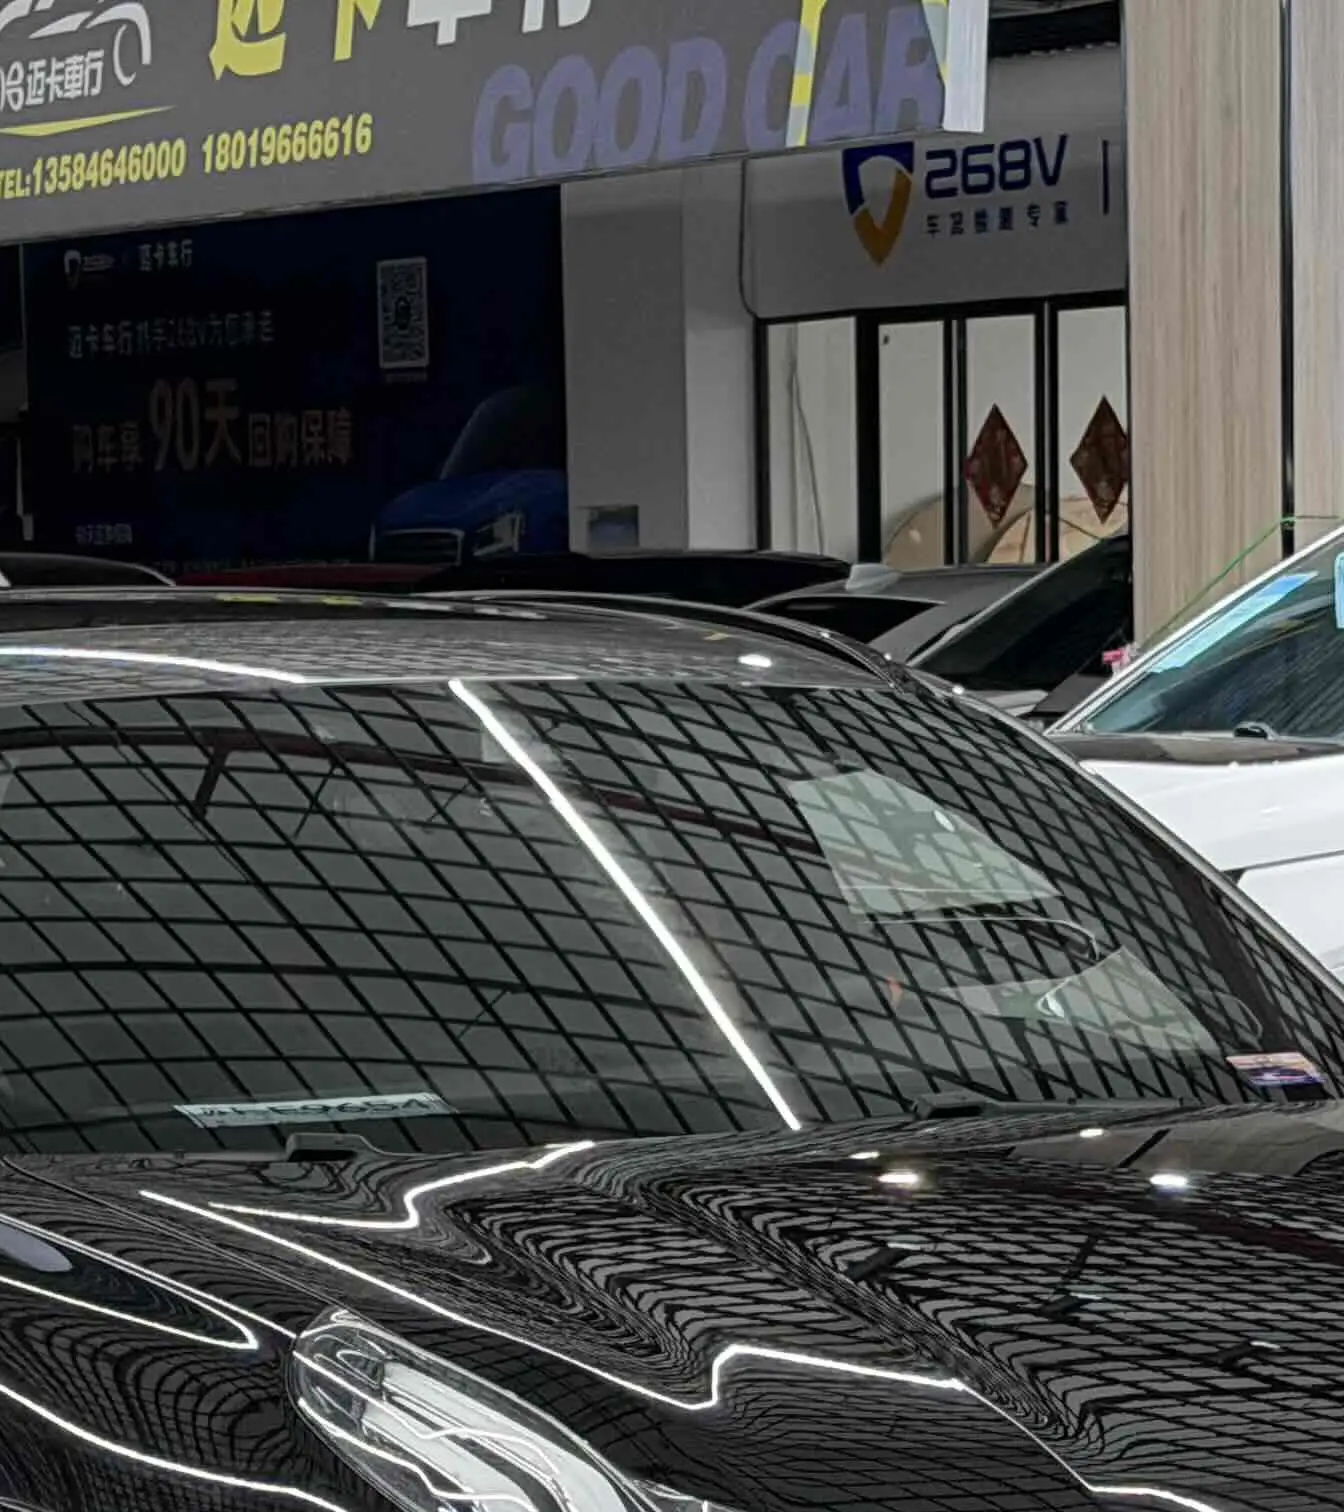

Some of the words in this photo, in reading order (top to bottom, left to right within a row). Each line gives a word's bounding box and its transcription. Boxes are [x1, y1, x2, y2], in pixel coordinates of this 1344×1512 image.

[202, 112, 373, 174] 18019666616
[472, 38, 727, 186] GOOD
[925, 134, 1068, 199] 268V
